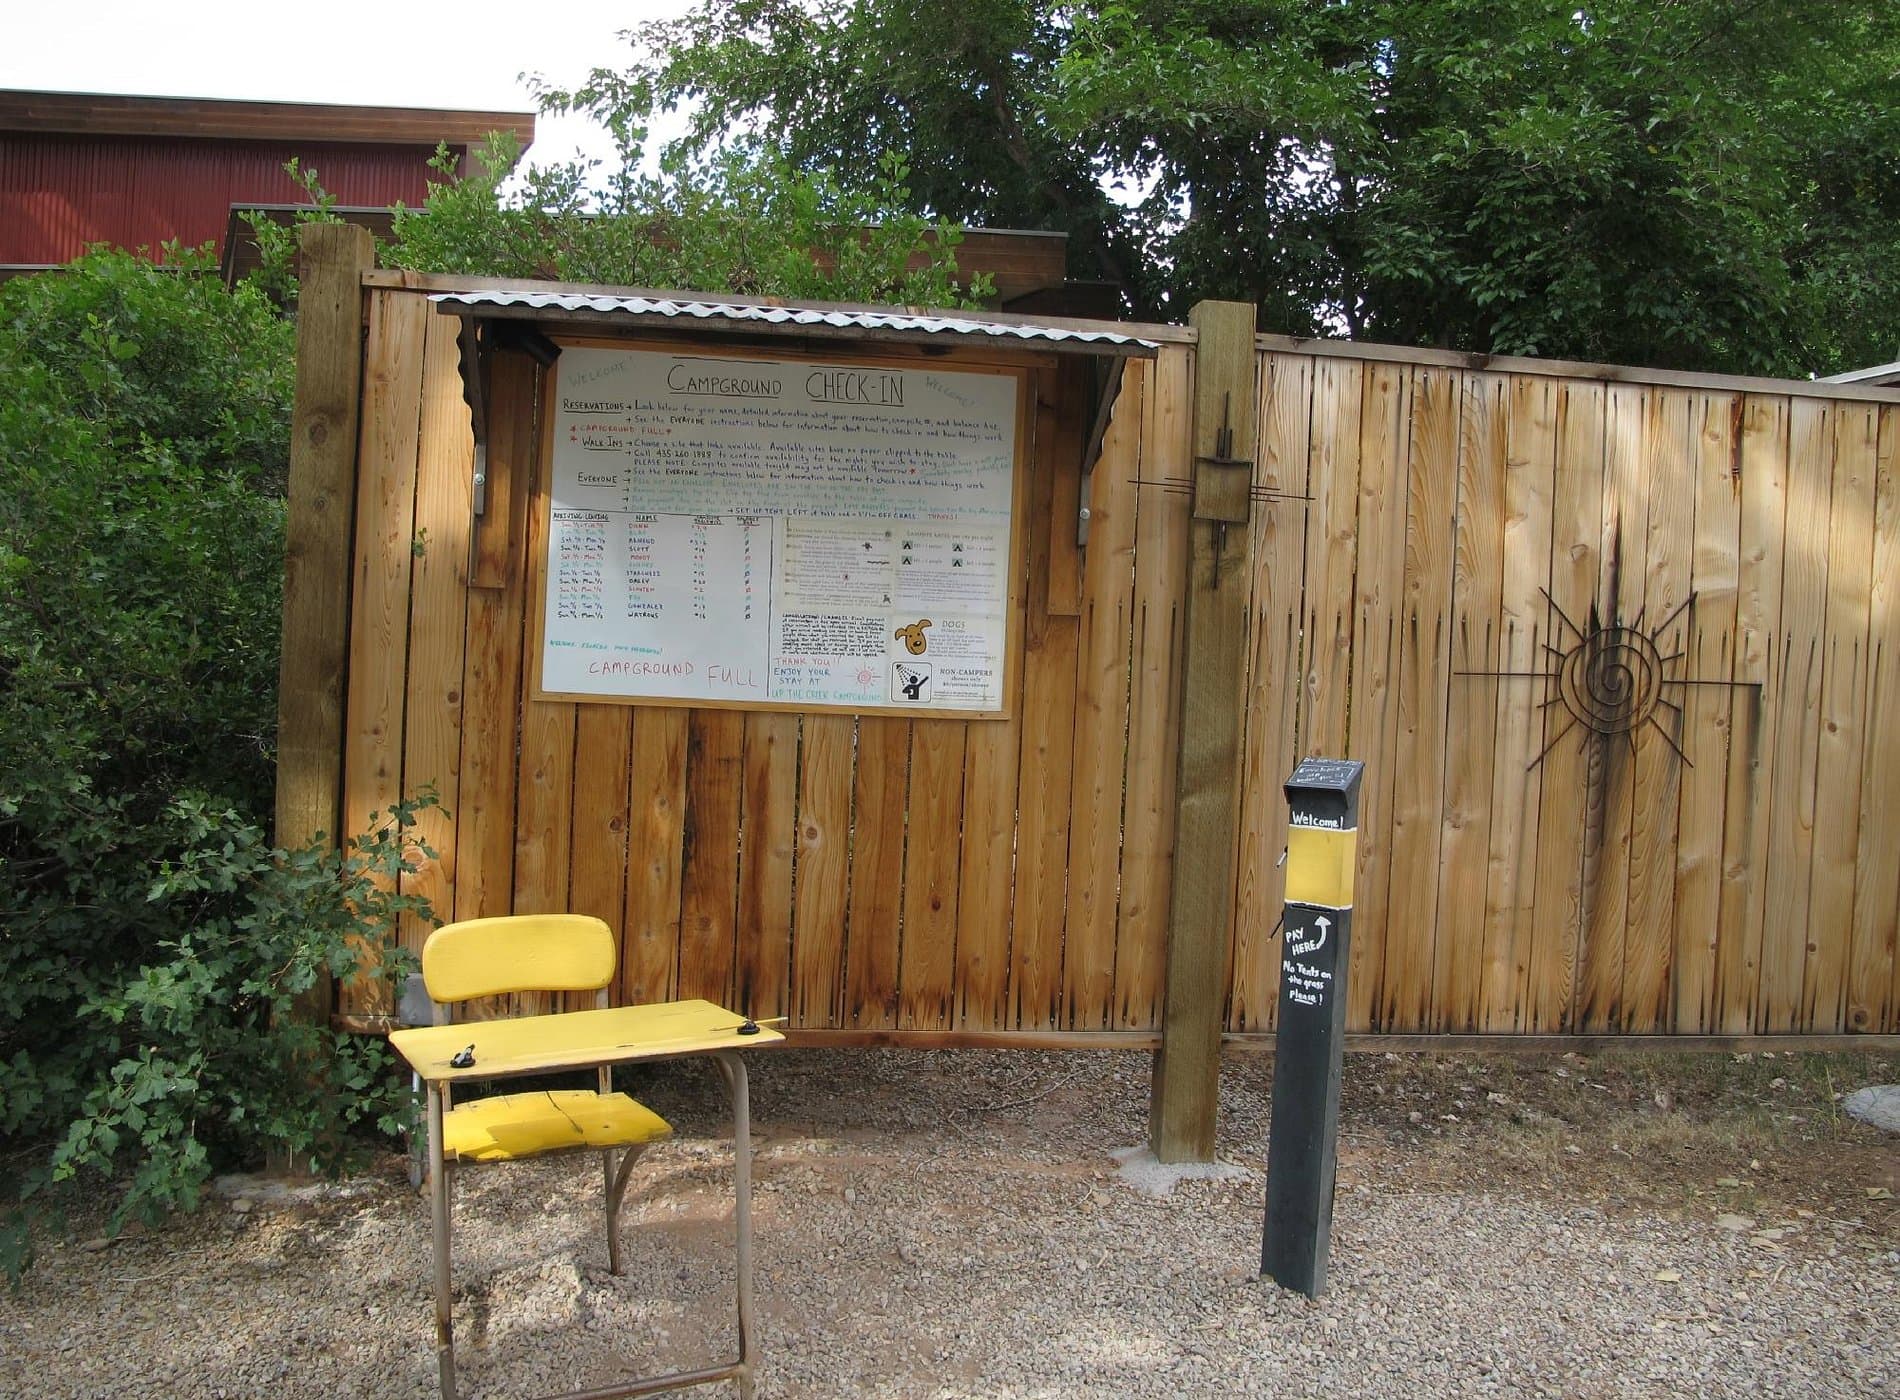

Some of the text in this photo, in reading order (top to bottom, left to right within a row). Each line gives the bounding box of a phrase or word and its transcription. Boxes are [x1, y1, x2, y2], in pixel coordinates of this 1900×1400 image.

[667, 364, 904, 404] CAMPGROUND CHECK-IN
[563, 399, 624, 411] RESERVATIONS
[635, 399, 654, 411] Look
[657, 401, 678, 412] below
[683, 404, 695, 413] for
[699, 407, 715, 416] your
[741, 407, 769, 417] detailed
[772, 410, 809, 418] information
[811, 411, 829, 419] about
[832, 415, 847, 423] your
[936, 419, 950, 427] and
[953, 419, 980, 429] balance
[580, 424, 664, 435] CAMPGROUND FULL
[634, 415, 648, 424] See
[670, 416, 705, 425] EVERYONE
[711, 418, 755, 426] instructions
[758, 419, 779, 428] below
[782, 420, 793, 429] for
[797, 421, 838, 431] information
[841, 424, 861, 432] about
[864, 426, 879, 434] how
[891, 428, 911, 436] check
[927, 429, 939, 437] and
[634, 440, 660, 448] Choose
[769, 442, 805, 452] Available
[885, 448, 912, 458] clipped
[634, 449, 650, 457] Call
[656, 450, 672, 458] 435
[674, 450, 690, 458] 260
[729, 452, 760, 460] confirm
[766, 453, 809, 463] availability
[634, 458, 661, 466] PLEASE
[578, 471, 617, 483] EVERYONE
[665, 468, 699, 477] EVERYONE
[746, 471, 765, 480] below
[785, 472, 825, 481] information
[942, 621, 966, 629] DOGS
[775, 657, 806, 666] THANK
[588, 661, 760, 688] CAMPGROUND FULL
[774, 667, 831, 677] ENJOY YOUR
[940, 667, 993, 677] NON-CAMPERS
[779, 677, 821, 686] STAY AT
[1292, 810, 1344, 829] Welcome!
[1286, 927, 1304, 944] PAY
[1292, 940, 1317, 957] HERE
[1283, 960, 1332, 980] No Tents on
[1288, 974, 1325, 990] the grass
